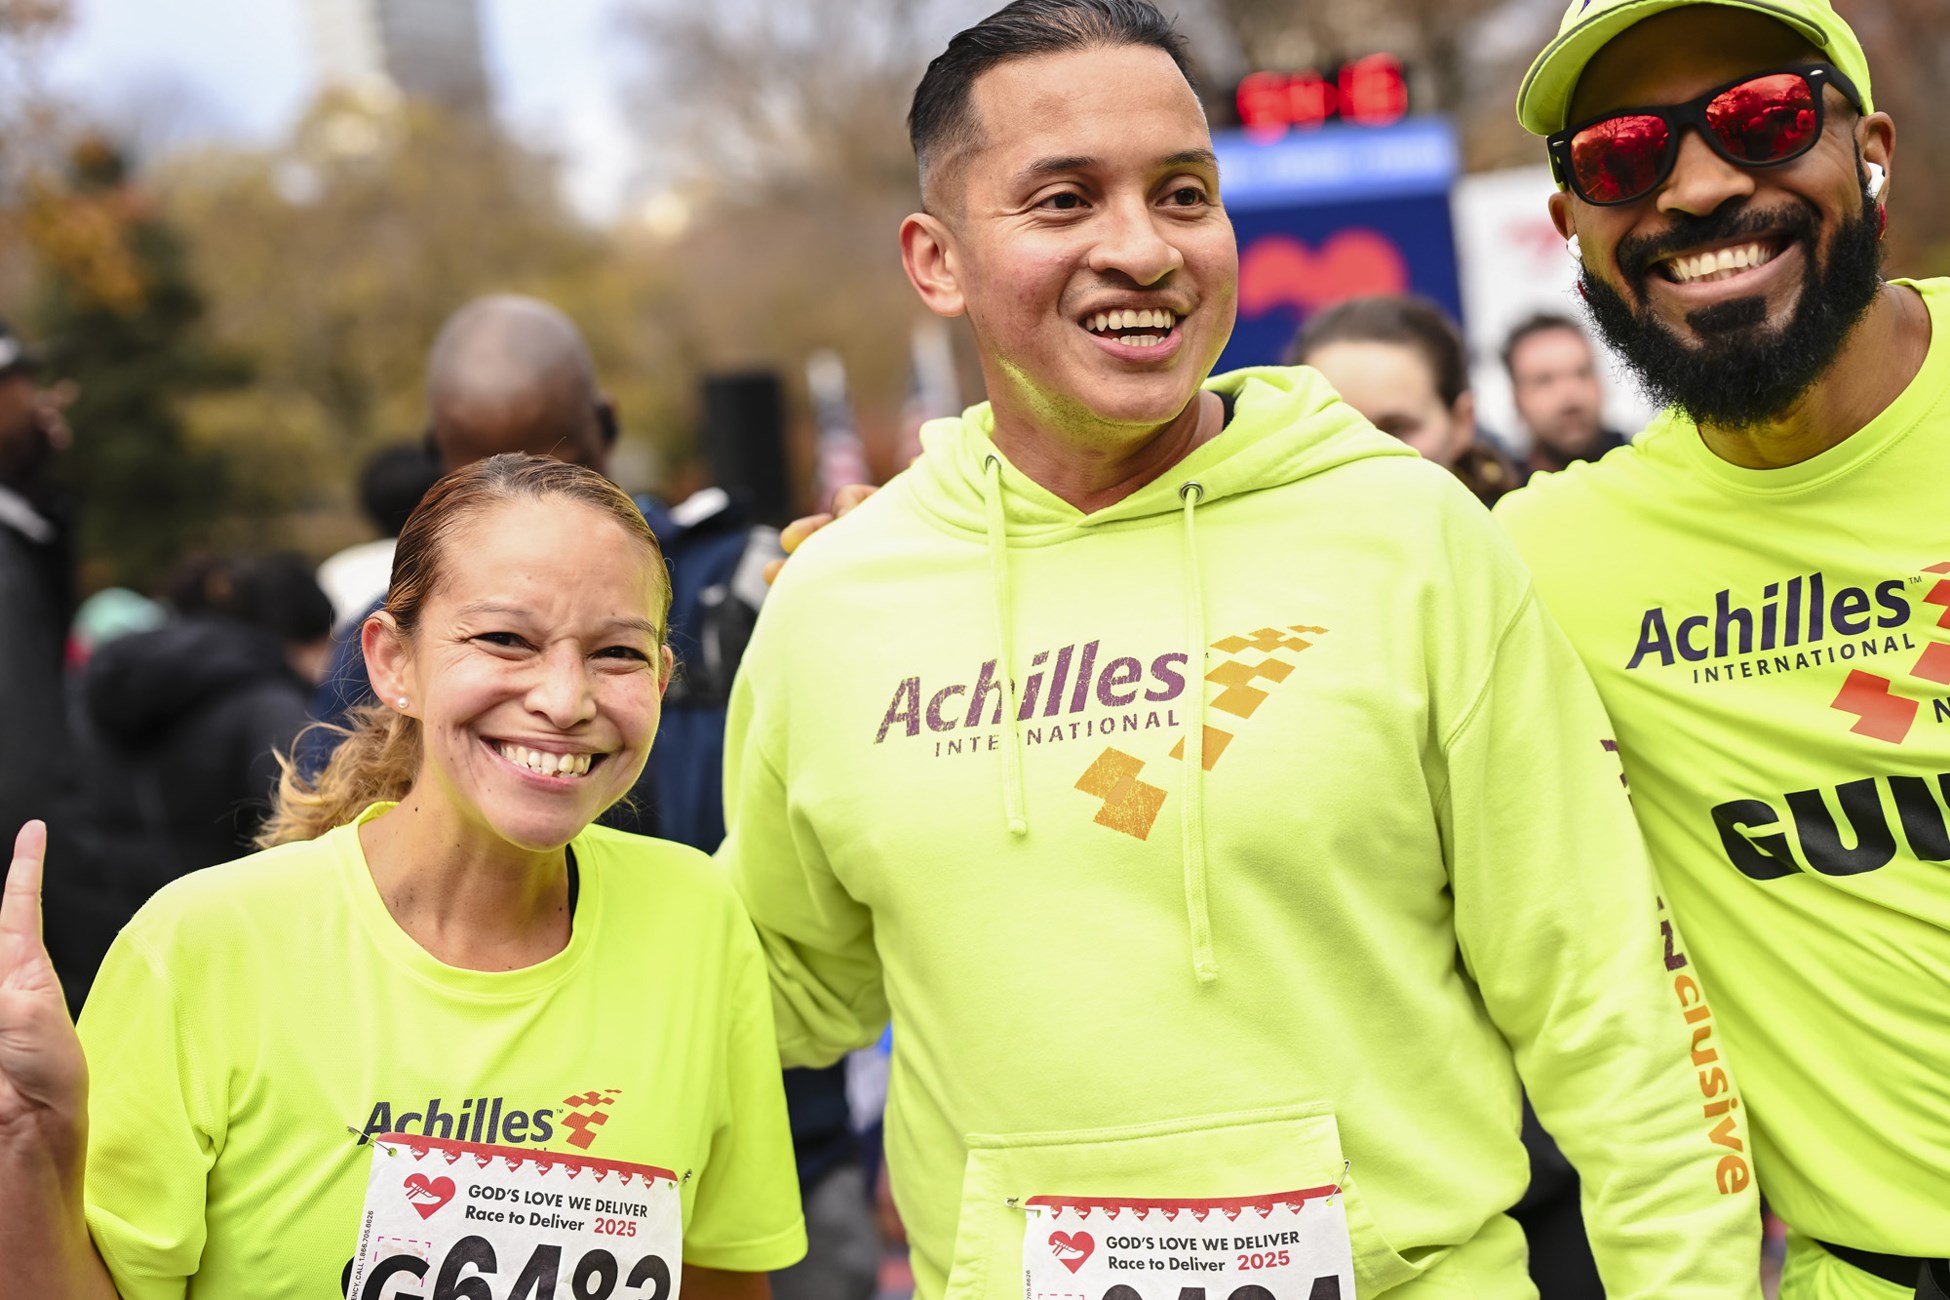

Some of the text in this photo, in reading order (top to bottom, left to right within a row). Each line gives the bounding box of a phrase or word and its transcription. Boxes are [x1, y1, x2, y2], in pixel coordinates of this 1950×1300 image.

[1625, 572, 1911, 670] Achilles
[1693, 633, 1915, 683] INTERNATIONAL
[873, 639, 1188, 745] Achilles
[935, 709, 1180, 757] INTENATIONAL
[1711, 772, 1950, 880] GUI
[357, 1097, 554, 1145] Achilles
[465, 1205, 637, 1237] Race to Deliver 2025
[468, 1184, 648, 1218] GOD'S LOVE WE DELIVER
[1106, 1231, 1300, 1251] GOD'S LOVE WE DELIVER
[1108, 1250, 1290, 1271] Race to Deliver 2025
[355, 1263, 365, 1280] CALL
